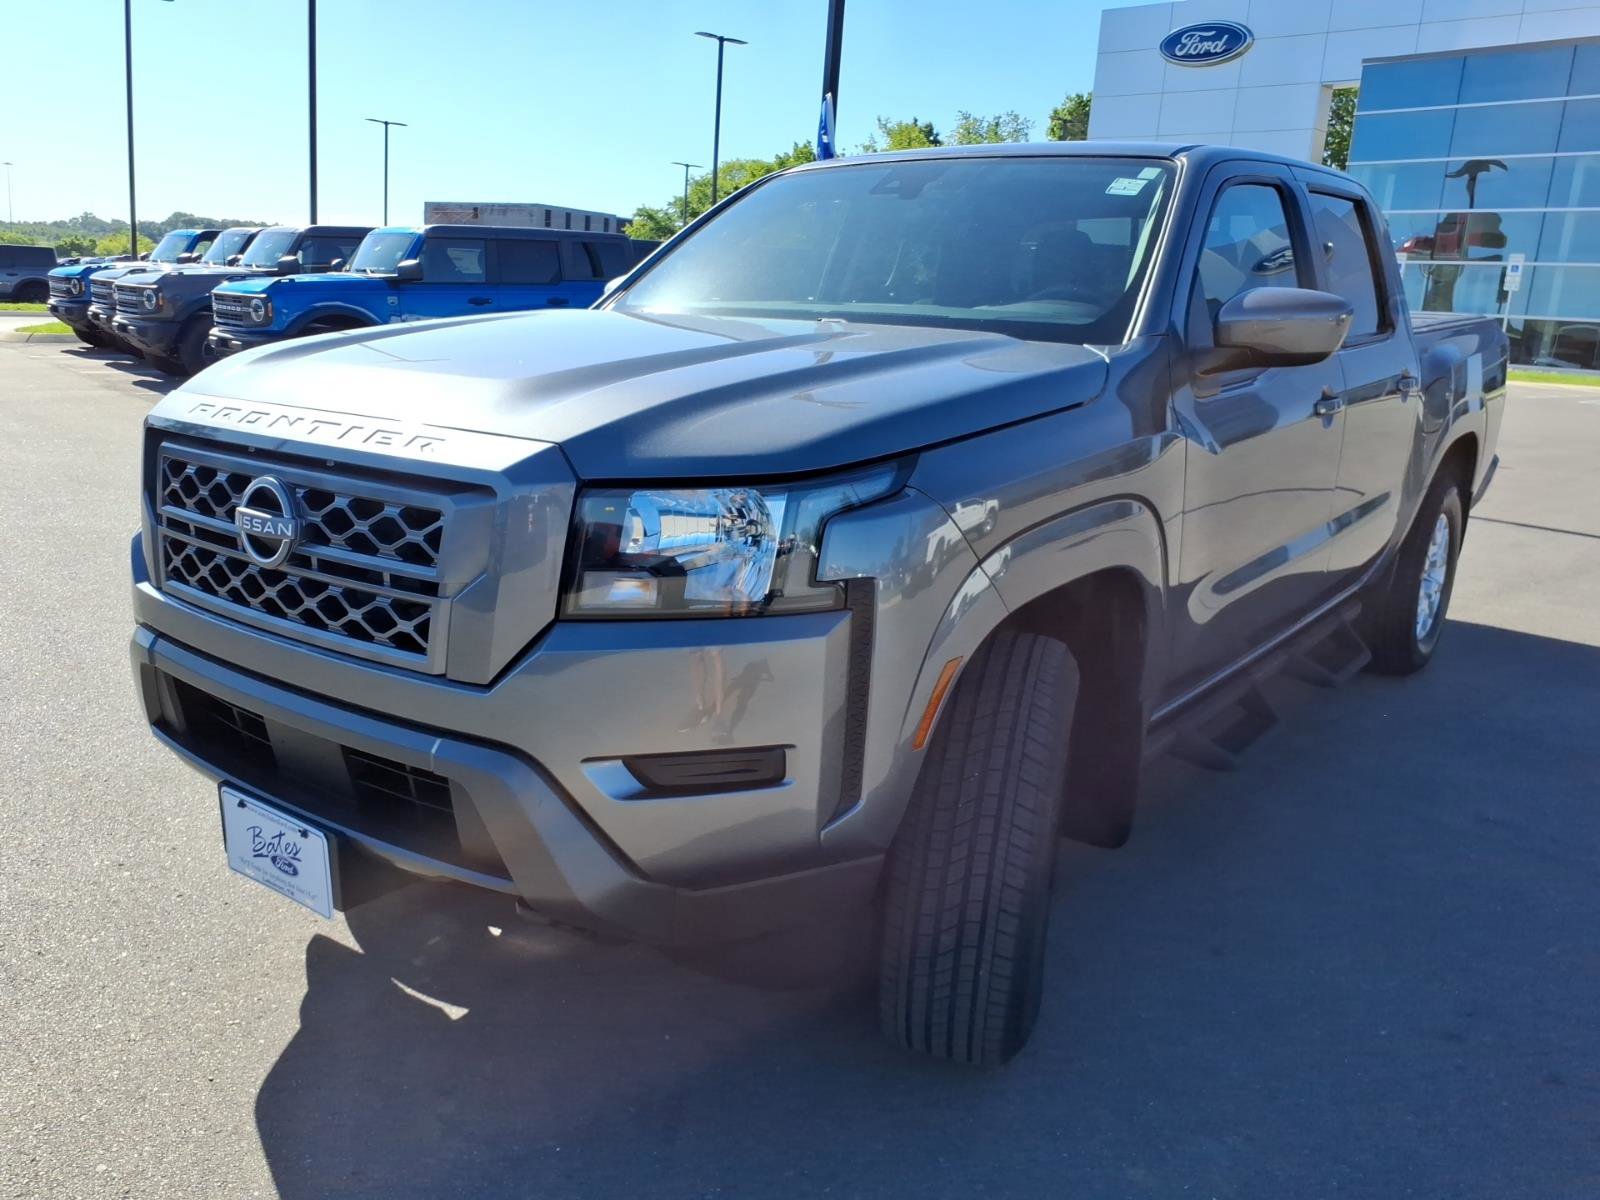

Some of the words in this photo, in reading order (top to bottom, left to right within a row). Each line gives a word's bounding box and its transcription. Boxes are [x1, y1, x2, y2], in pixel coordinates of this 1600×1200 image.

[1175, 31, 1229, 56] Ford
[188, 402, 446, 452] FRONTIER
[246, 826, 302, 857] Bates
[275, 856, 295, 874] Ford
